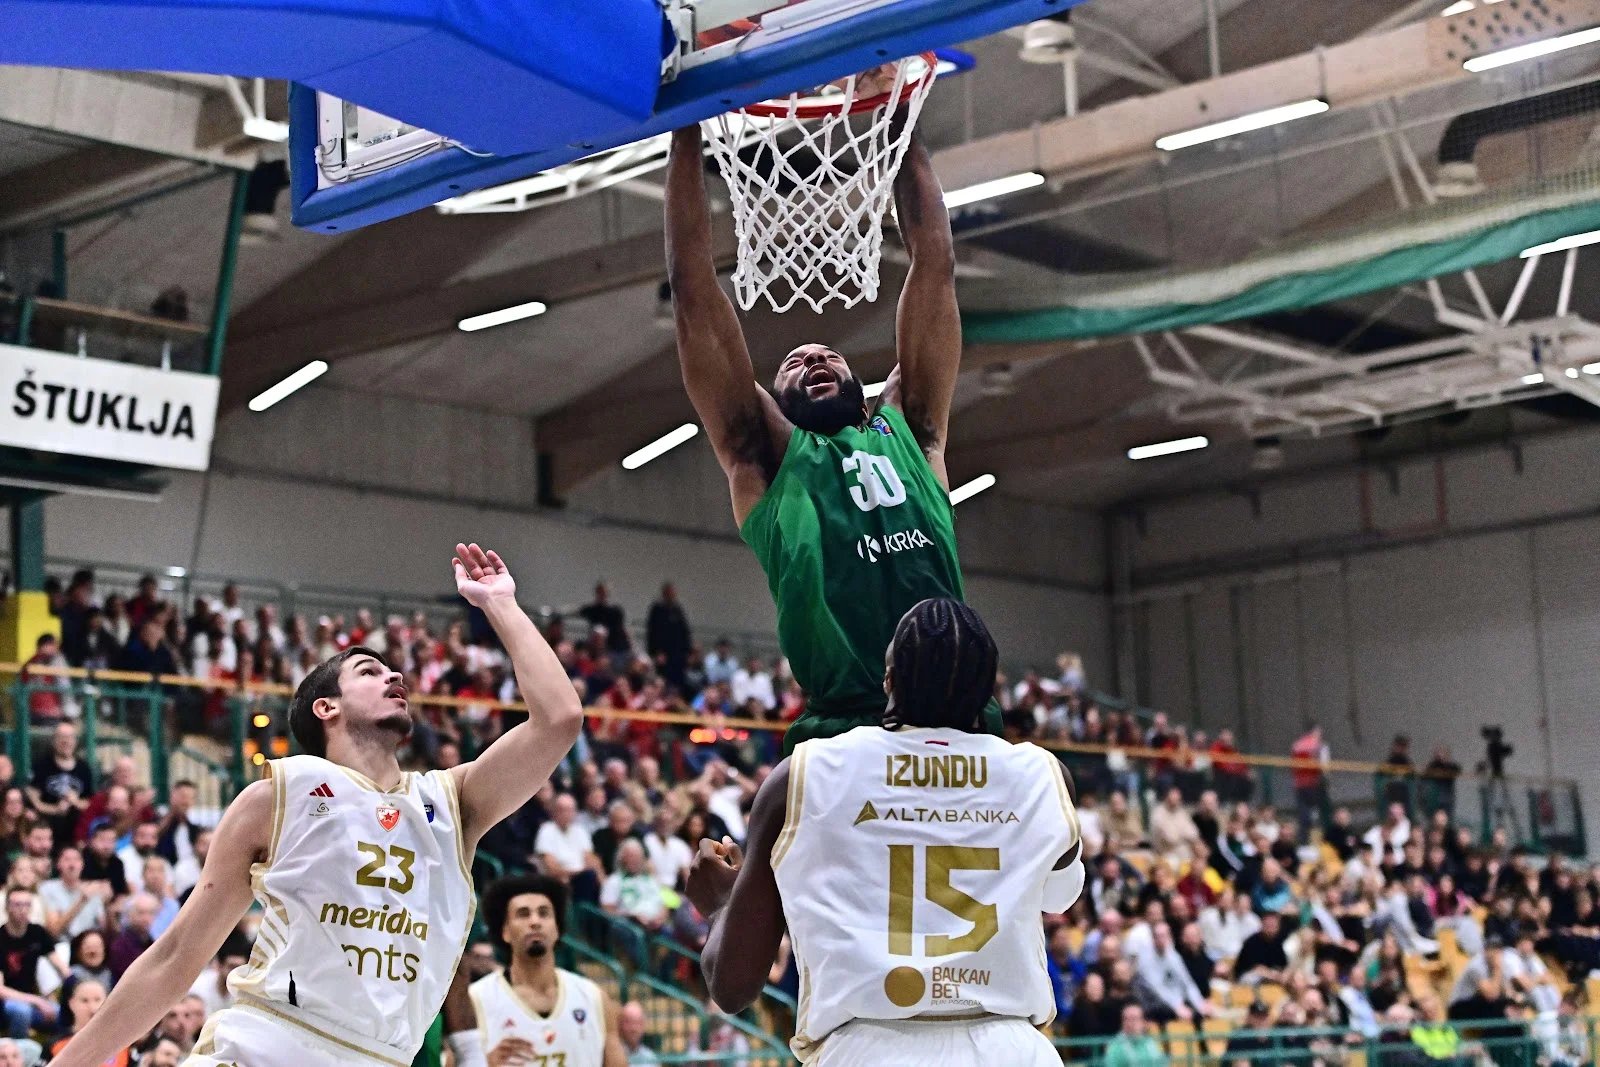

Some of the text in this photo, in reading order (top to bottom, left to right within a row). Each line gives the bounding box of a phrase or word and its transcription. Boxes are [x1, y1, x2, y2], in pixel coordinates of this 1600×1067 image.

[13, 368, 194, 440] ŠTUKLJA
[842, 450, 907, 512] 30
[883, 528, 935, 553] KRKA
[886, 754, 988, 789] IZUNDU
[356, 840, 416, 895] 23
[887, 844, 1000, 958] 15
[341, 943, 421, 983] mts
[932, 966, 991, 986] BALKAN
[931, 982, 961, 999] BET
